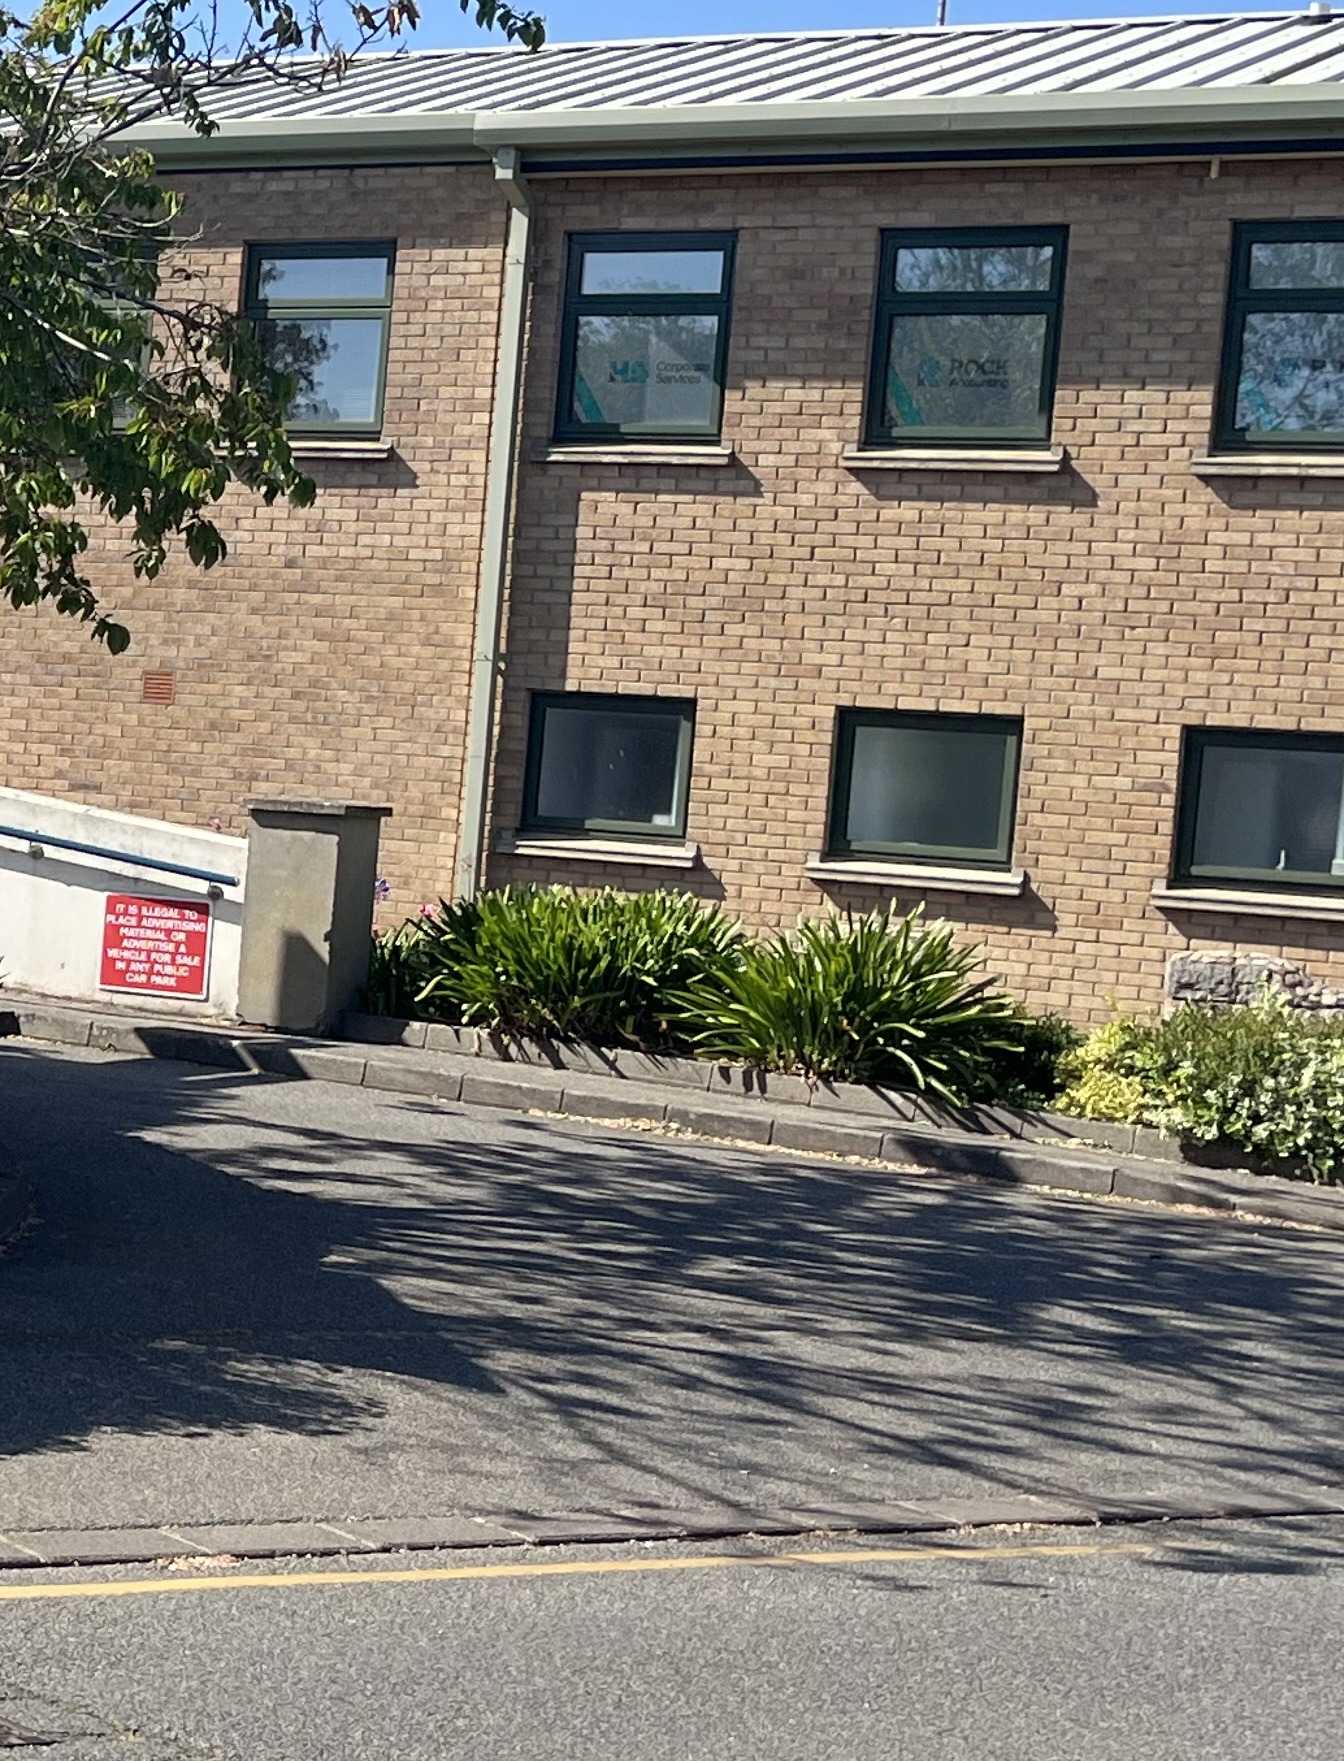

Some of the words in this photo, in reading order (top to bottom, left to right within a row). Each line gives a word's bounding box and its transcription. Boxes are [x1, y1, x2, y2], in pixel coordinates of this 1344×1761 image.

[115, 904, 125, 913] IT
[127, 905, 138, 914] IS
[141, 906, 181, 918] ILLEGAL
[183, 910, 198, 919] TO
[106, 914, 137, 926] PLACE
[141, 918, 206, 932] ADVERTISING
[119, 927, 167, 940] MATERIAL
[170, 932, 186, 941] OR
[121, 939, 175, 952] ADVERTISE
[178, 944, 186, 953] A
[106, 948, 148, 961] VEHICLE
[150, 953, 172, 963] FOR
[175, 955, 201, 967] SALE
[115, 960, 126, 970] IN
[129, 962, 151, 972] ANY
[153, 964, 190, 977] PUBLIC
[125, 973, 147, 983] CAR
[150, 976, 177, 987] PARK
